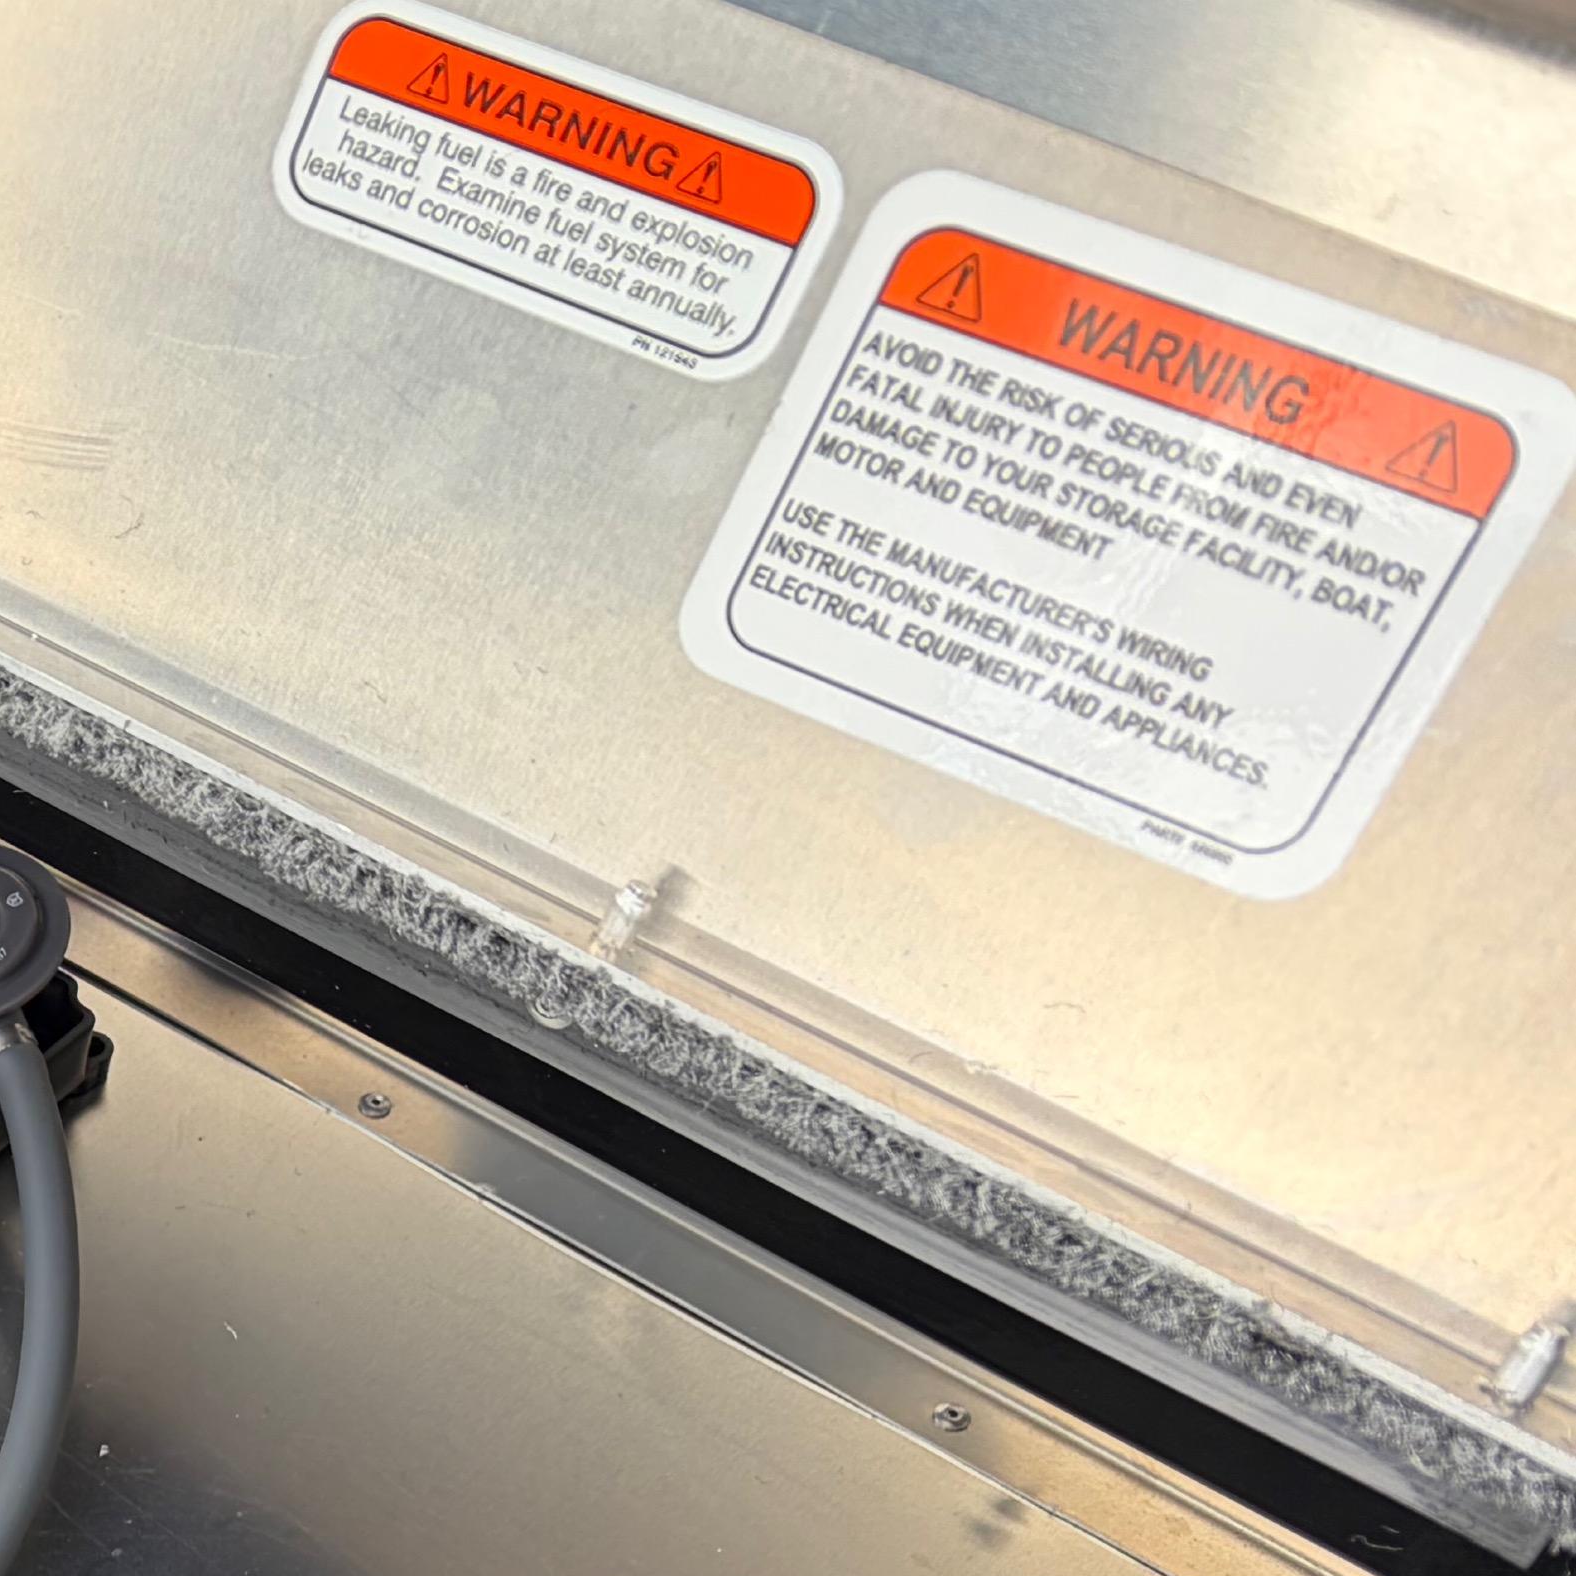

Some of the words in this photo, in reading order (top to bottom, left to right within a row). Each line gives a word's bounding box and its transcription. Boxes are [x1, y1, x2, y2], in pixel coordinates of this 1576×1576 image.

[338, 129, 421, 181] hazard.
[437, 166, 541, 225] Examine
[545, 208, 594, 244] fuel
[595, 233, 686, 280] system
[690, 262, 729, 293] for
[339, 96, 431, 156] Leaking
[435, 132, 483, 168] fuel
[484, 150, 506, 178] is
[511, 167, 528, 187] a
[533, 169, 572, 202] fire
[575, 191, 629, 223] and
[631, 211, 754, 270] explosion
[463, 71, 681, 181] WARNING
[302, 149, 363, 191] leaks
[367, 180, 415, 210] and
[418, 199, 530, 254] corrosion
[534, 244, 561, 267] at
[563, 249, 626, 291] least
[627, 280, 736, 337] annually.
[863, 332, 943, 376] AVOID
[947, 358, 999, 396] THE
[998, 379, 1062, 419] RISK
[1064, 403, 1105, 431] OF
[1104, 417, 1219, 476] SERIOUS
[1223, 463, 1283, 499] AND
[1284, 483, 1362, 529] EVEN
[1058, 298, 1309, 427] WARNING
[814, 432, 905, 484] MOTOR
[904, 468, 961, 504] AND
[962, 488, 1114, 560] EQUIPMENT
[831, 399, 940, 456] DAMAGE
[943, 439, 978, 470] TO
[983, 453, 1054, 499] YOUR
[1056, 482, 1181, 546] STORAGE
[1183, 529, 1305, 599] FACILITY,
[1311, 577, 1393, 633] BOAT,
[847, 364, 922, 412] FATAL
[929, 395, 1024, 445] INJURY
[1026, 428, 1062, 460] TO
[1063, 444, 1170, 499] PEOPLE
[1171, 484, 1250, 529] FROM
[1251, 513, 1316, 554] FIRE
[1315, 540, 1425, 597] AND/OR
[750, 564, 890, 640] ELECTRICAL
[897, 623, 1044, 694] EQUIPMENT
[1041, 683, 1101, 719] AND
[1101, 705, 1268, 788] APPLIANCES.
[765, 532, 940, 616] INSTRUCTIONS
[944, 601, 1019, 647] WHEN
[1020, 633, 1171, 706] INSTALLING
[1170, 692, 1234, 729] ANY
[783, 499, 834, 536] USE
[837, 519, 886, 556] THE
[885, 539, 1114, 644] MANUFACTURER'S
[1117, 628, 1213, 682] WIRING
